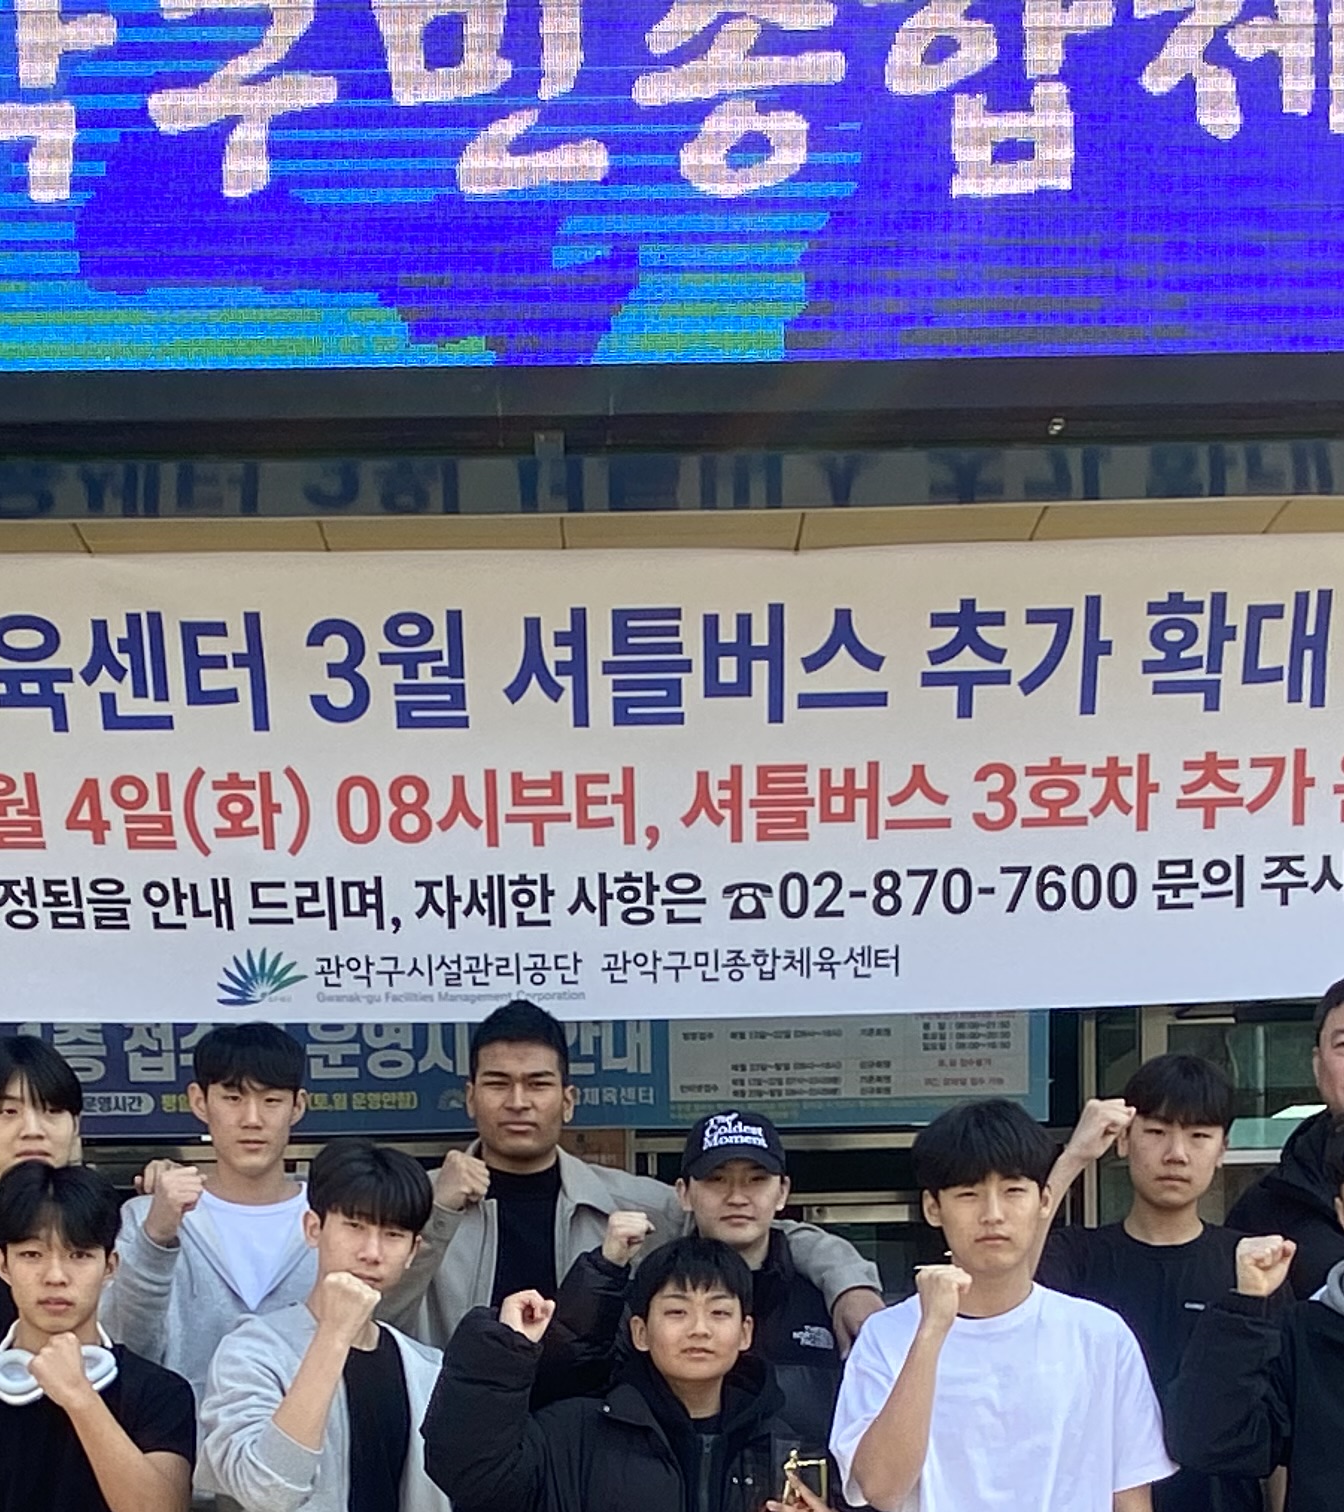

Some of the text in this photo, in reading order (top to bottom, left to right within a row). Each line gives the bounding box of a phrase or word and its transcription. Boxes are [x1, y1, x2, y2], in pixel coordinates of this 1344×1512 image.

[306, 611, 469, 728] 3월
[504, 603, 888, 729] 셔틀버스
[921, 595, 1112, 718] 추가
[1142, 592, 1332, 710] 확대
[65, 767, 310, 856] 4일(화)
[335, 766, 659, 850] 08시부터,
[680, 760, 951, 845] 셔틀버스
[972, 752, 1160, 832] 3호차
[1176, 747, 1316, 830] 추가
[142, 876, 235, 931] 안내
[247, 876, 402, 934] 드리며,
[415, 873, 556, 930] 자세한
[567, 871, 708, 928] 사항은
[1151, 853, 1245, 911] 문의
[314, 943, 901, 988] 관악구시설관리공단 관악구민종합체육센터
[306, 1022, 472, 1080] 운영시
